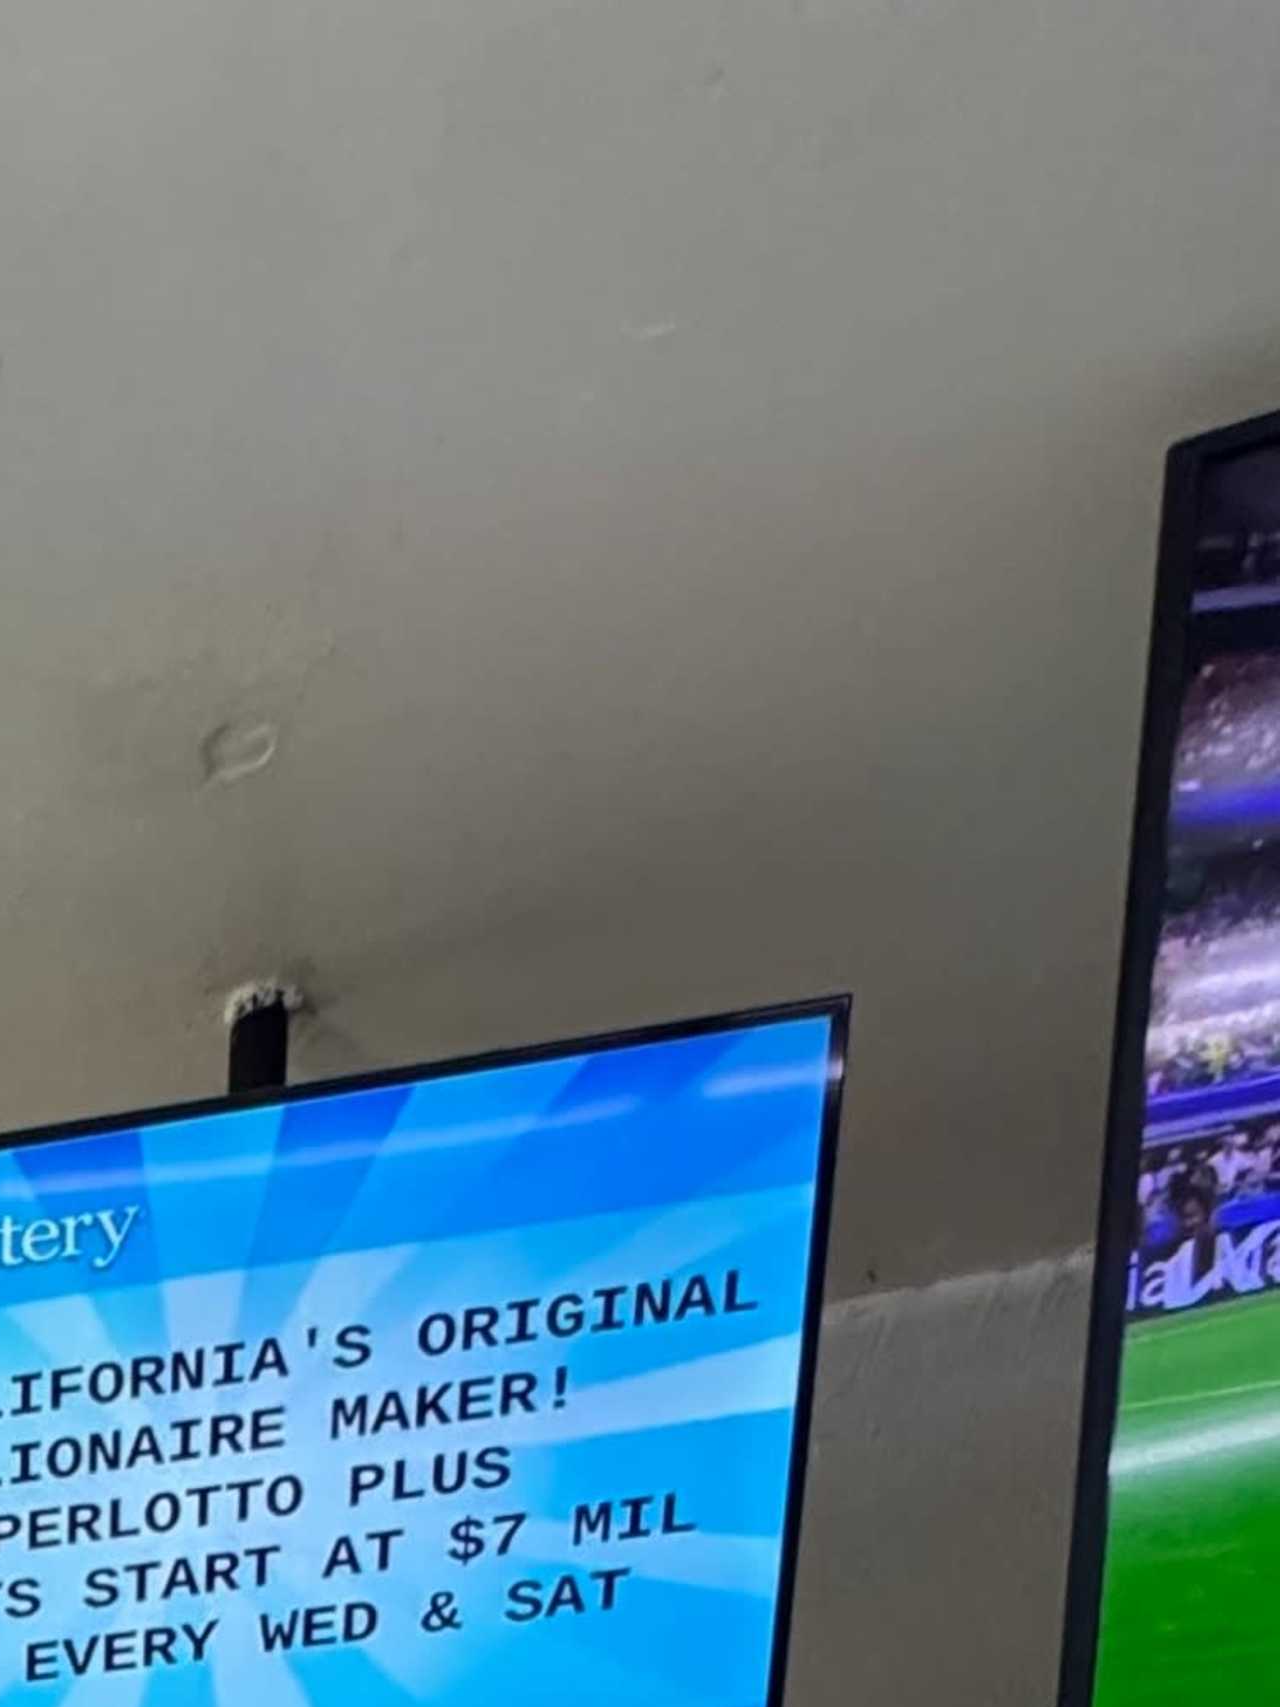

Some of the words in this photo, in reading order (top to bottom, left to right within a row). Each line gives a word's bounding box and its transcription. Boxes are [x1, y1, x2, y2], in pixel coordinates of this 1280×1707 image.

[417, 1270, 758, 1357] ORIGINAL
[331, 1367, 569, 1440] MAKER!
[349, 1446, 511, 1506] PLUS
[84, 1546, 281, 1608] START
[322, 1530, 404, 1578] AT
[449, 1513, 527, 1567] $7
[573, 1492, 696, 1546] MIL
[26, 1621, 218, 1682] EVERY
[261, 1602, 378, 1653] WED
[421, 1592, 463, 1632] &
[505, 1569, 632, 1622] SAT
